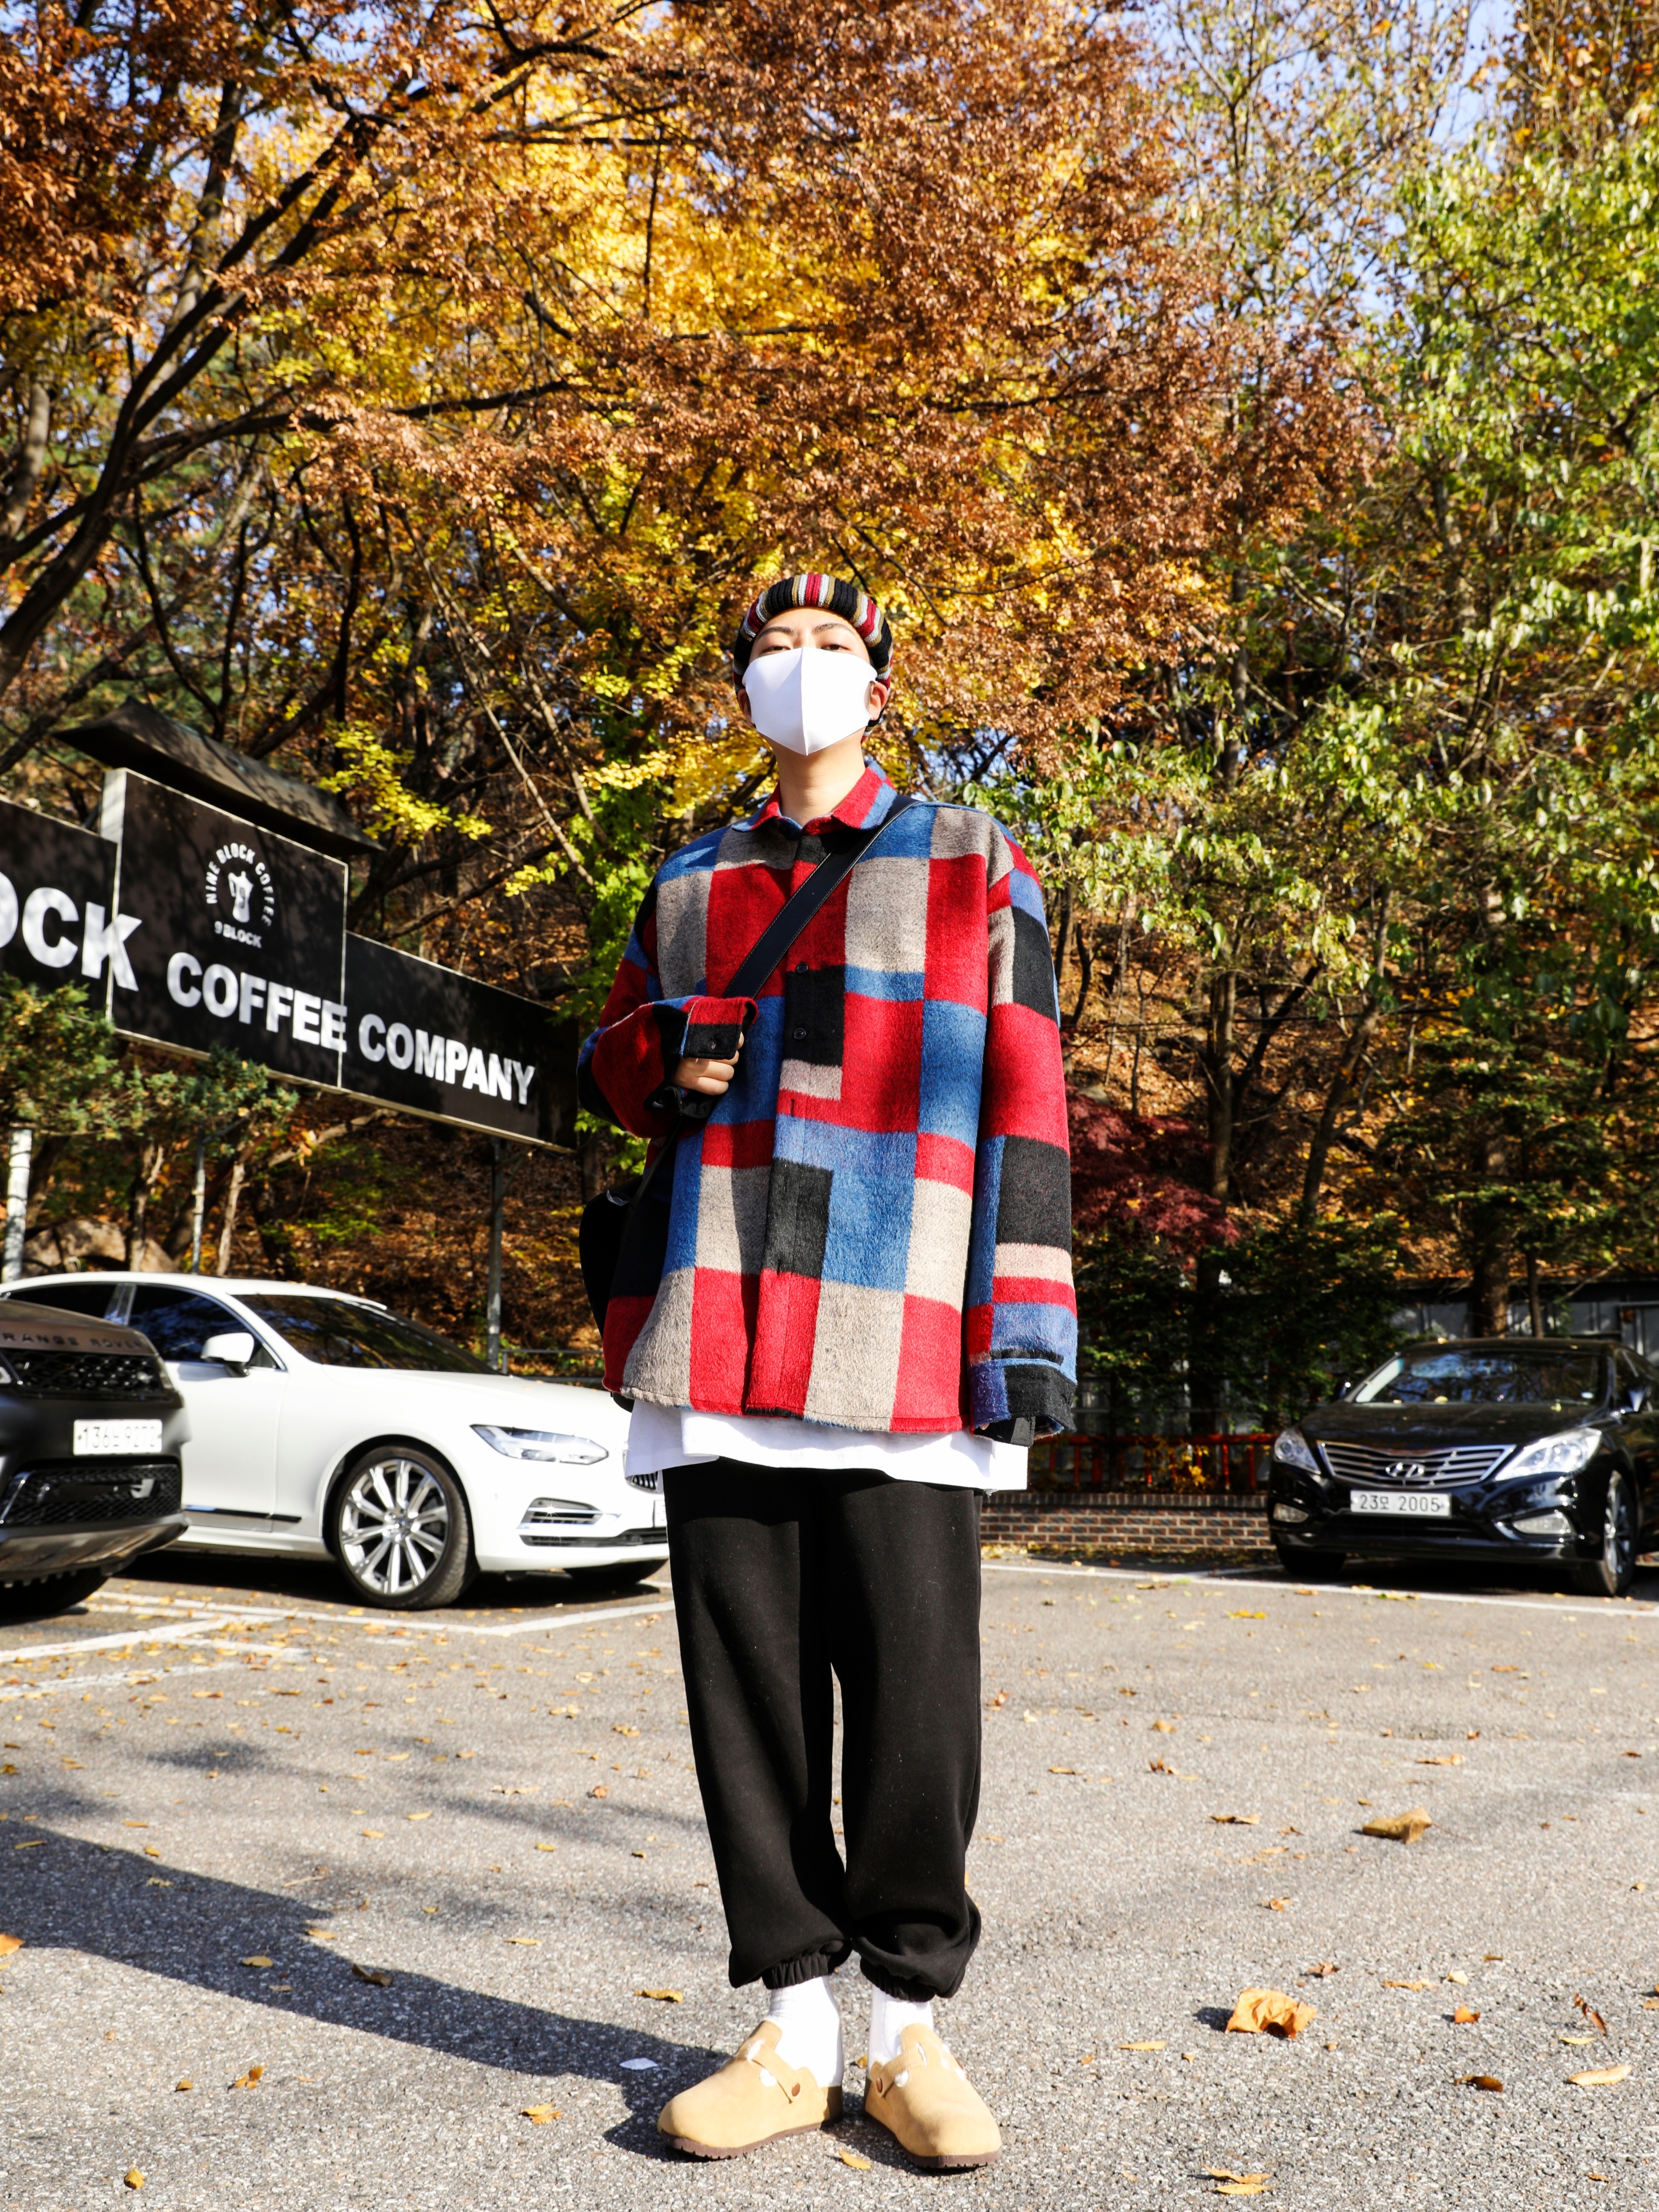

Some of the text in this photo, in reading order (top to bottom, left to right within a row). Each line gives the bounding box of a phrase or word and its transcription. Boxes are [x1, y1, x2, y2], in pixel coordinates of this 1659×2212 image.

[205, 842, 275, 927] NINE BLOCK COFFEE
[0, 871, 536, 1105] CK COFFEE COMPANY
[2, 1332, 142, 1348] RANGE ROVER
[124, 1425, 156, 1448] 9272
[1398, 1495, 1441, 1513] 2005
